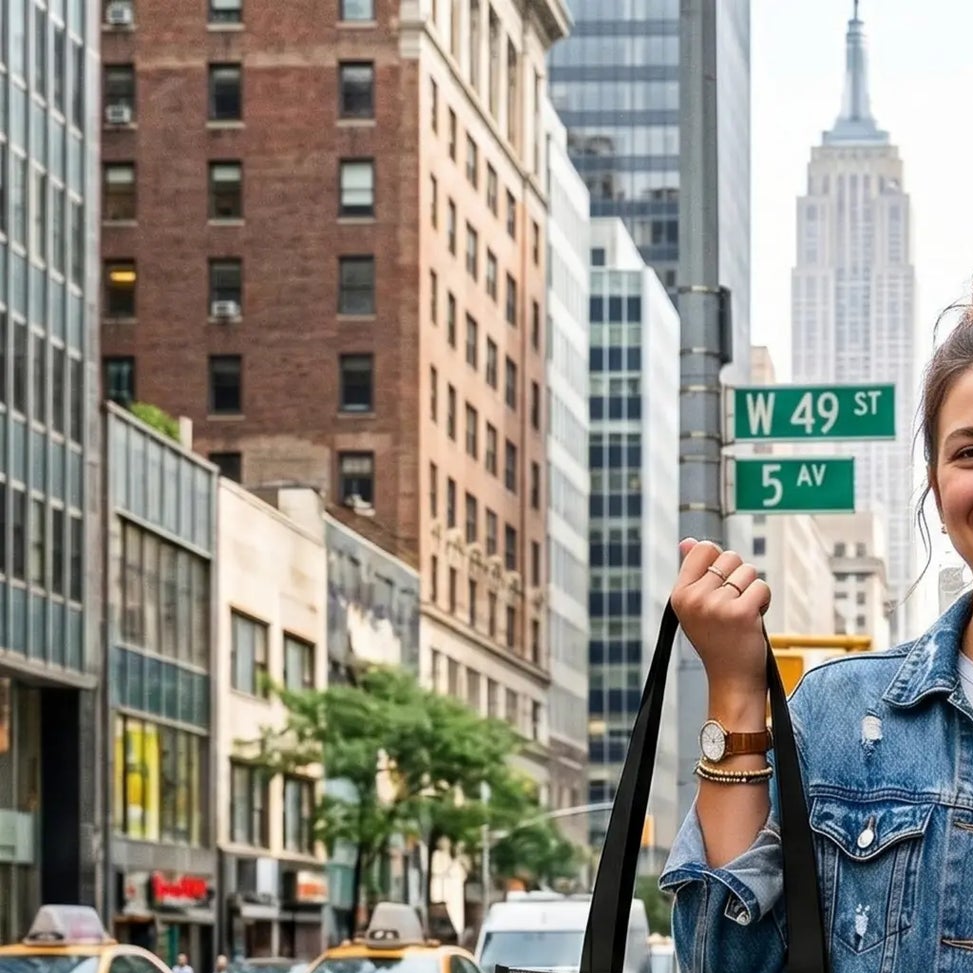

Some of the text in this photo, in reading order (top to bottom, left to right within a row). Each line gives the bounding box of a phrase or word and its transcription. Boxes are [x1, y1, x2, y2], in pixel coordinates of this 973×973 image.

[746, 391, 882, 435] W 49 ST
[761, 463, 827, 507] 5 AV
